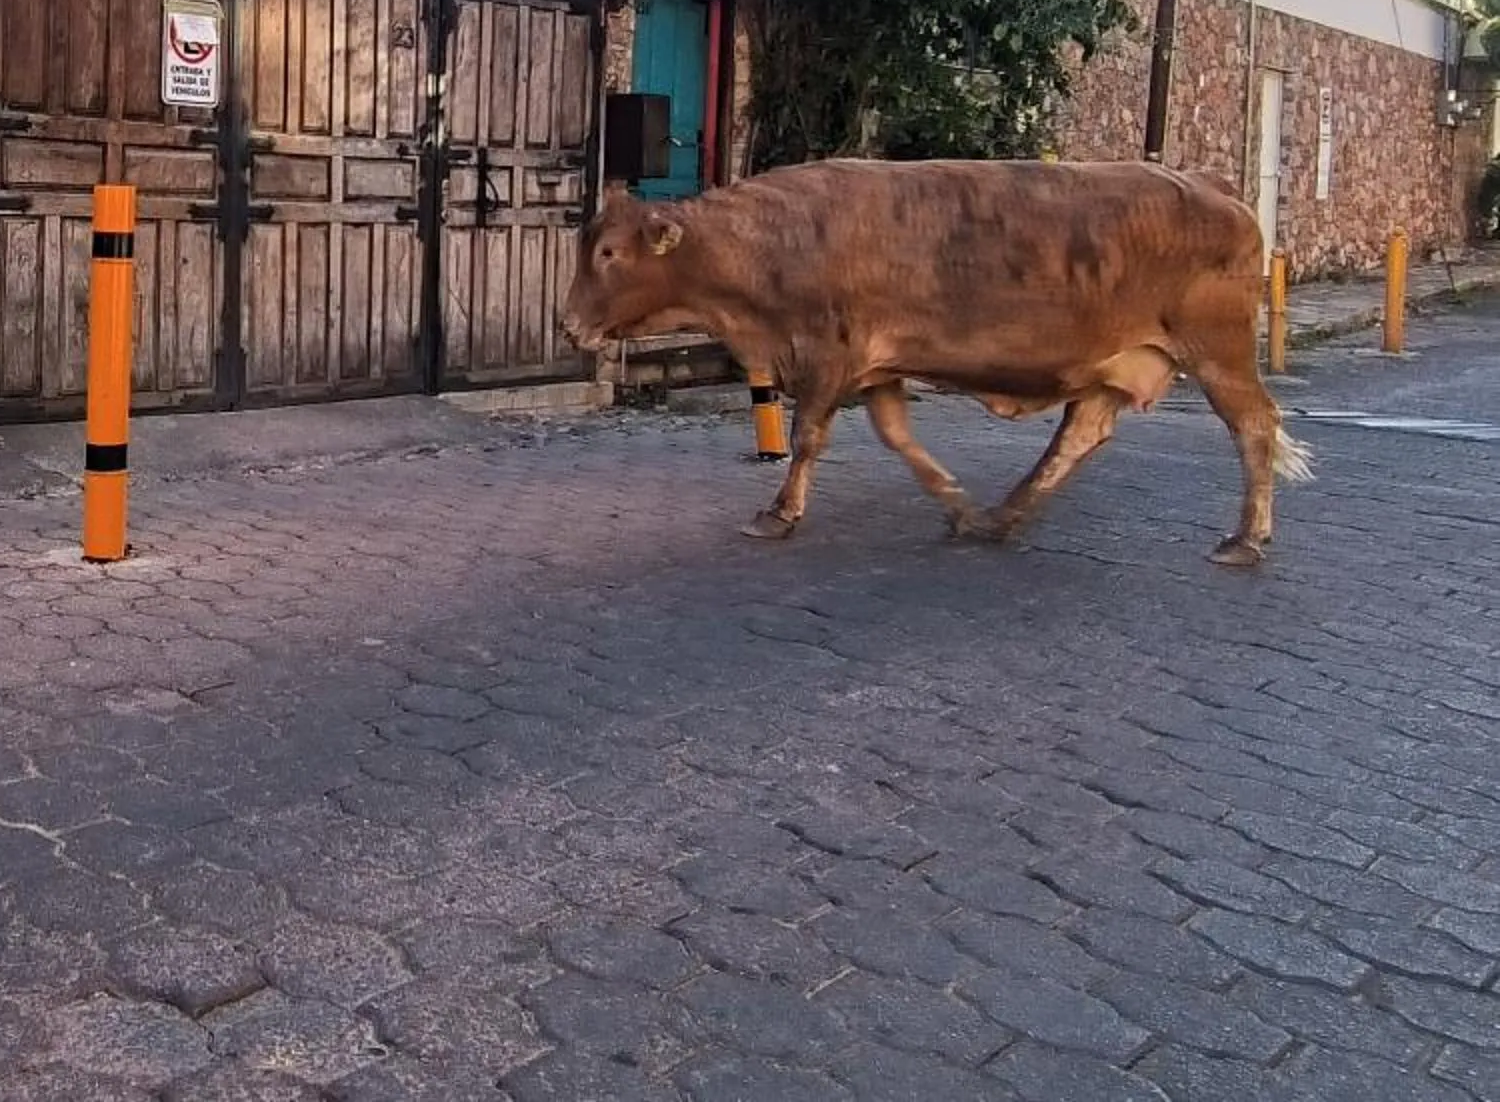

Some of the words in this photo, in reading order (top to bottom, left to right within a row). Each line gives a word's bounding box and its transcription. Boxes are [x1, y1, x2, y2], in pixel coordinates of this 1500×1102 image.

[170, 65, 204, 76] ENTRADA
[172, 76, 197, 85] SALIDA
[199, 77, 209, 86] DE
